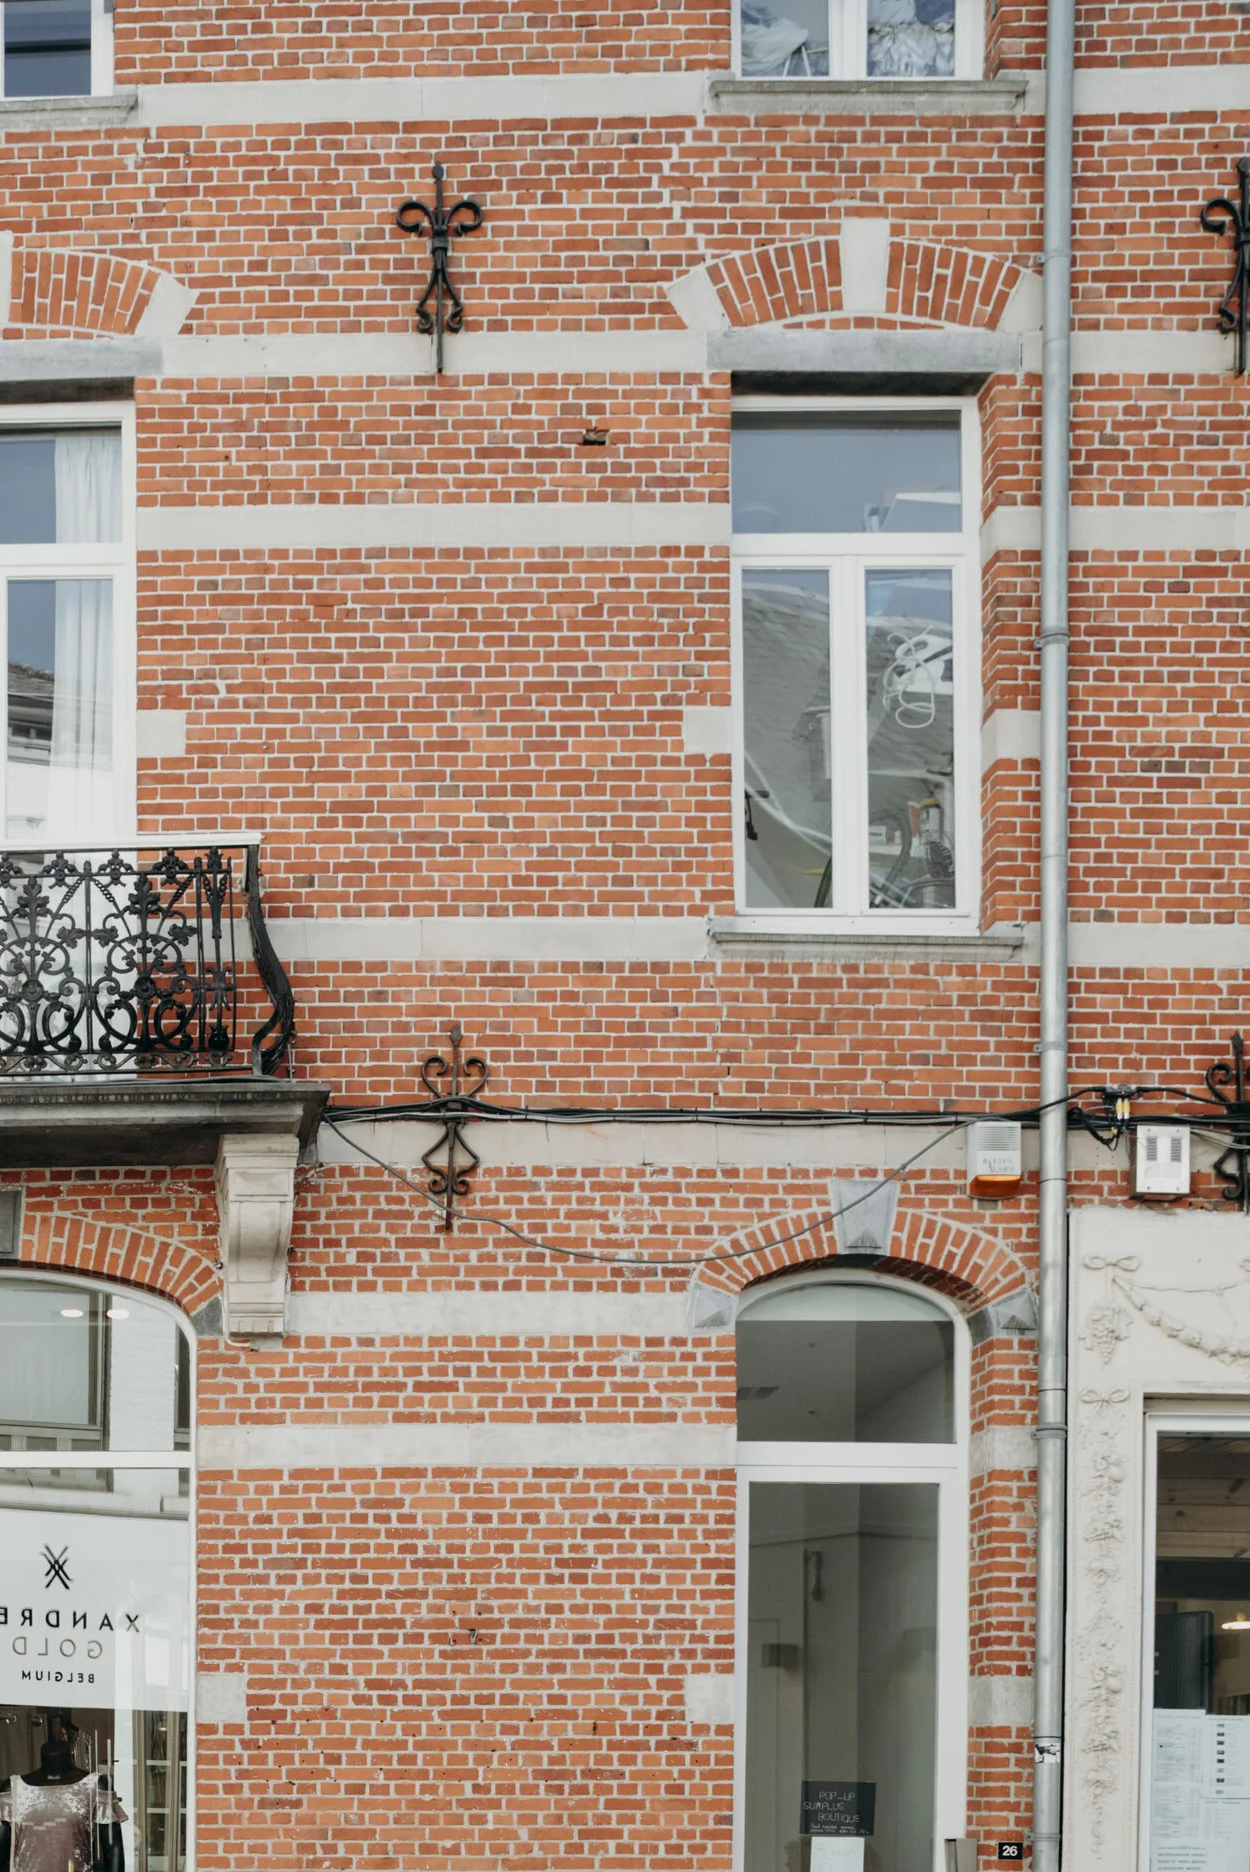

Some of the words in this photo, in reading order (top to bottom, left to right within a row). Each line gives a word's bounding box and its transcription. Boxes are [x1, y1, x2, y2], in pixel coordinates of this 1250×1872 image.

[818, 1791, 856, 1801] POP-UP
[803, 1801, 845, 1811] SURPLUS
[817, 1812, 860, 1823] BOUTIQUE
[1002, 1845, 1018, 1857] 26
